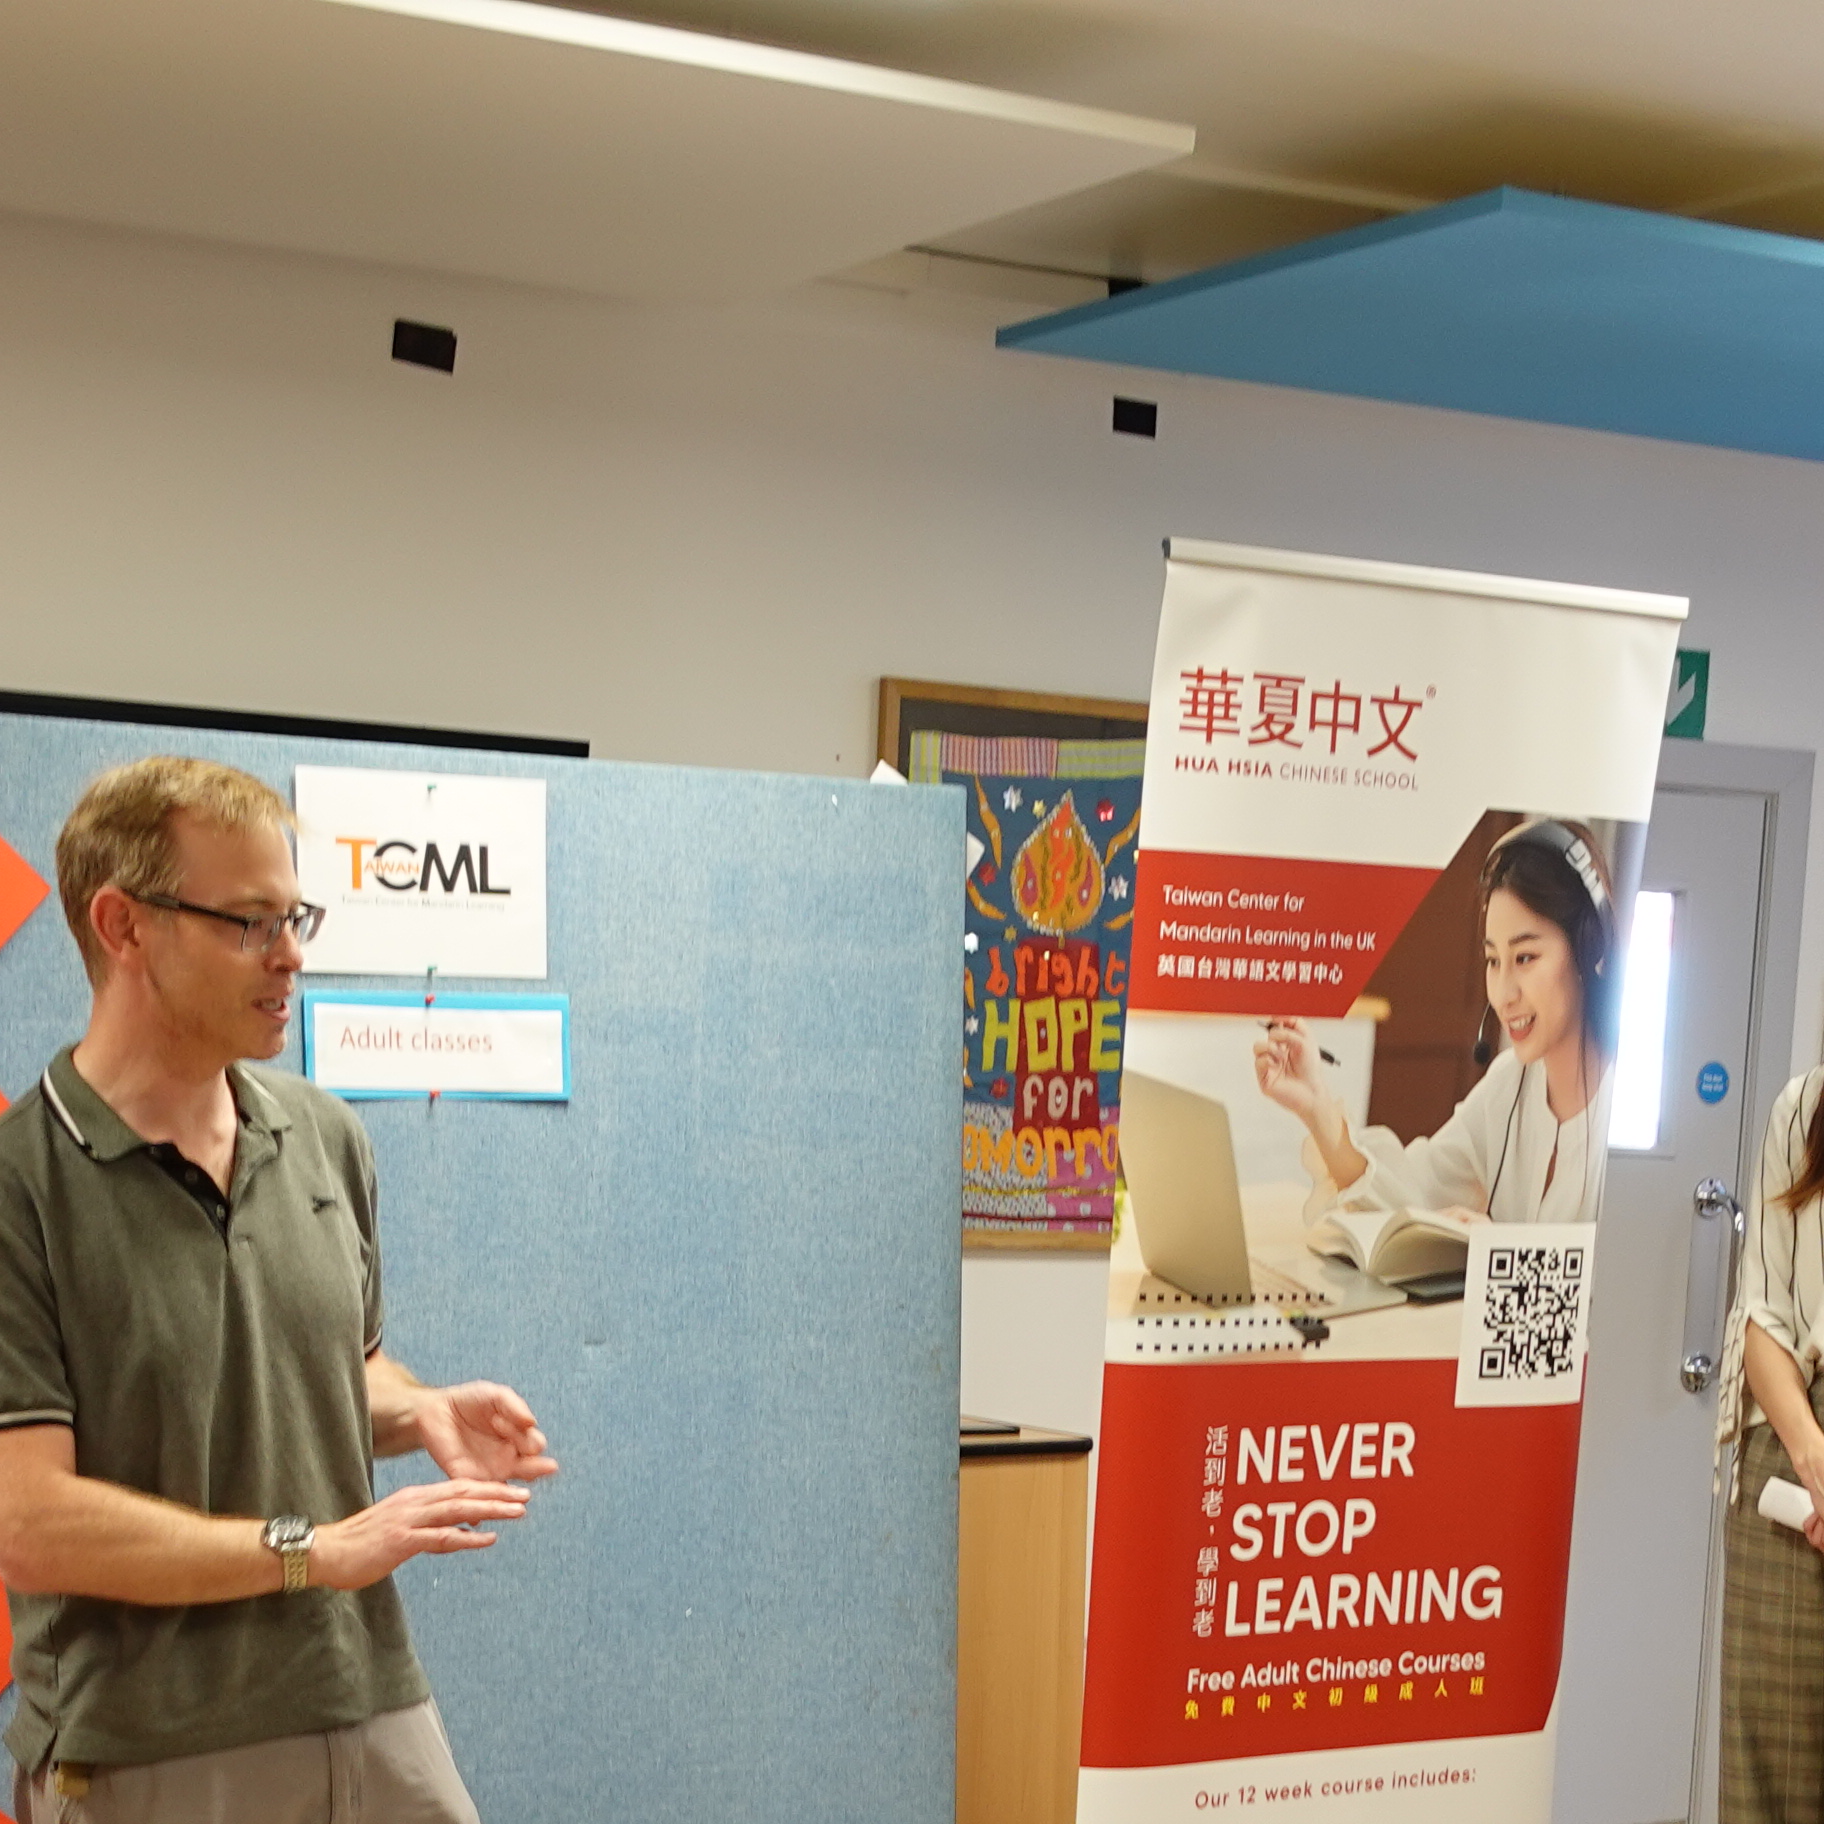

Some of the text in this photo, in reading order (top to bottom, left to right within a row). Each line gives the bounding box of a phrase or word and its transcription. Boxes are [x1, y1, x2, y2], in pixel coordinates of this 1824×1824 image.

[1178, 666, 1424, 763] 華夏中文
[1175, 755, 1419, 791] HUA HSIA CHINESE SCHOOL
[335, 836, 511, 895] TCML
[1163, 884, 1305, 913] Taiwan Center for
[1159, 919, 1377, 952] Mandarin Learning in the UK
[985, 945, 1127, 999] bright
[340, 1025, 493, 1052] Adult classes
[981, 995, 1122, 1073] HOPE
[1023, 1074, 1095, 1121] for
[1237, 1421, 1416, 1485] NEVER
[1230, 1498, 1376, 1562] STOP
[1225, 1565, 1503, 1638] LEARNING
[1187, 1650, 1486, 1694] Free Adult Chinese Courses
[1195, 1766, 1477, 1810] Our 12 week course includes:
